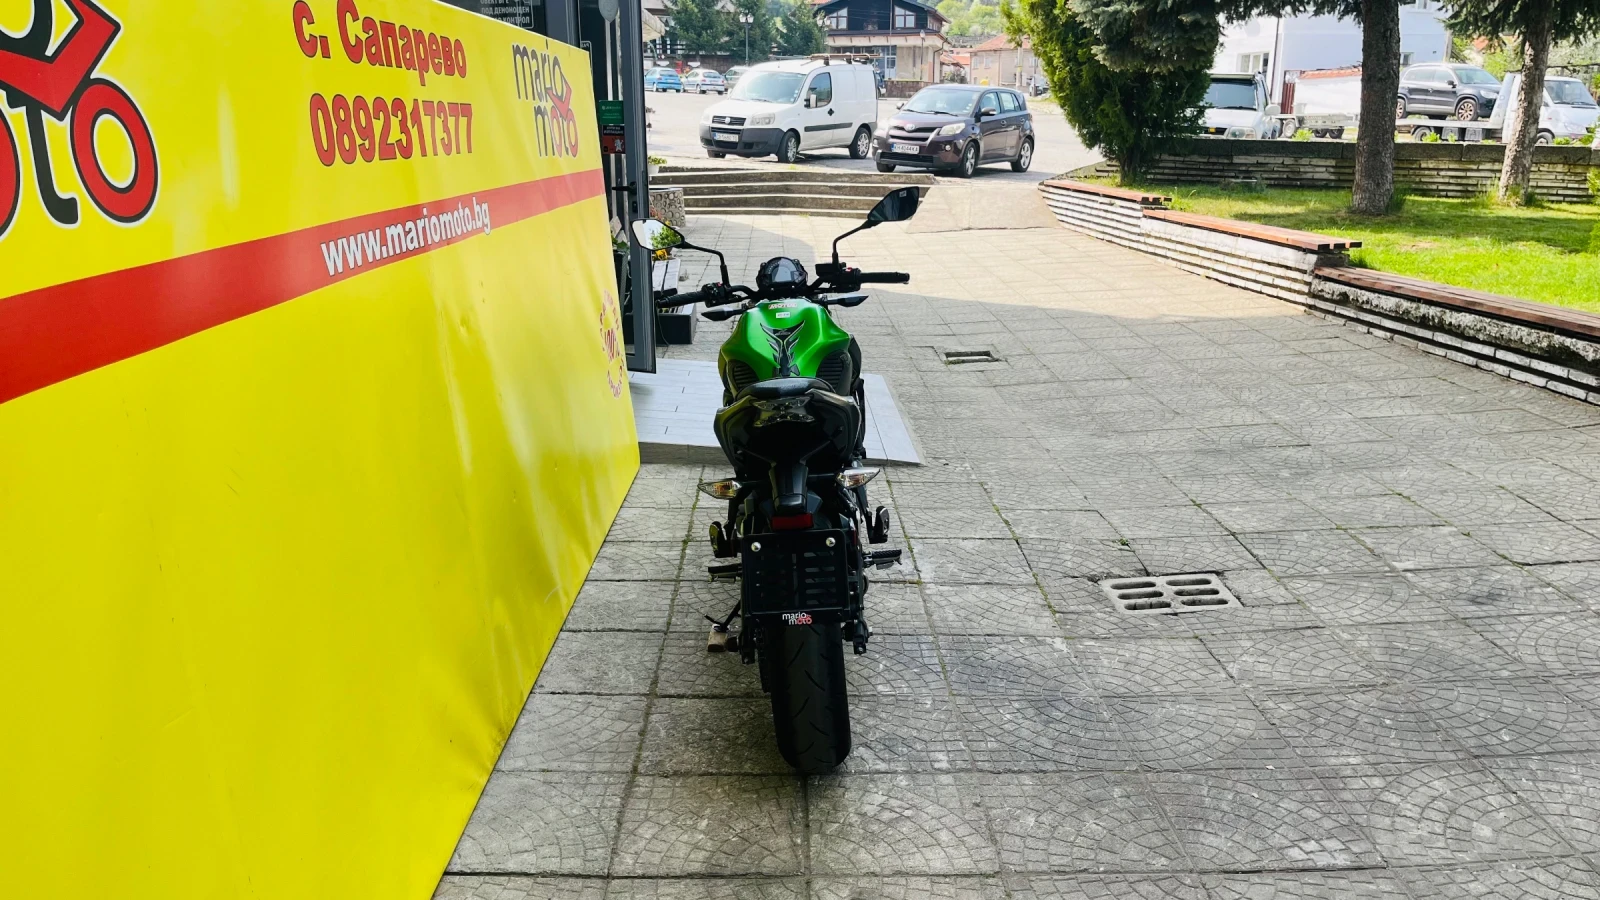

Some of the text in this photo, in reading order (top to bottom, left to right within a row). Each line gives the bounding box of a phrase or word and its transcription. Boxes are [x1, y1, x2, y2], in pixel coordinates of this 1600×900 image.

[337, 0, 467, 86] Сапарево
[512, 38, 564, 103] mario
[310, 93, 473, 167] 0892317377
[534, 105, 579, 158] moto
[320, 196, 491, 277] www.mariomoto.bg
[782, 611, 806, 620] mario
